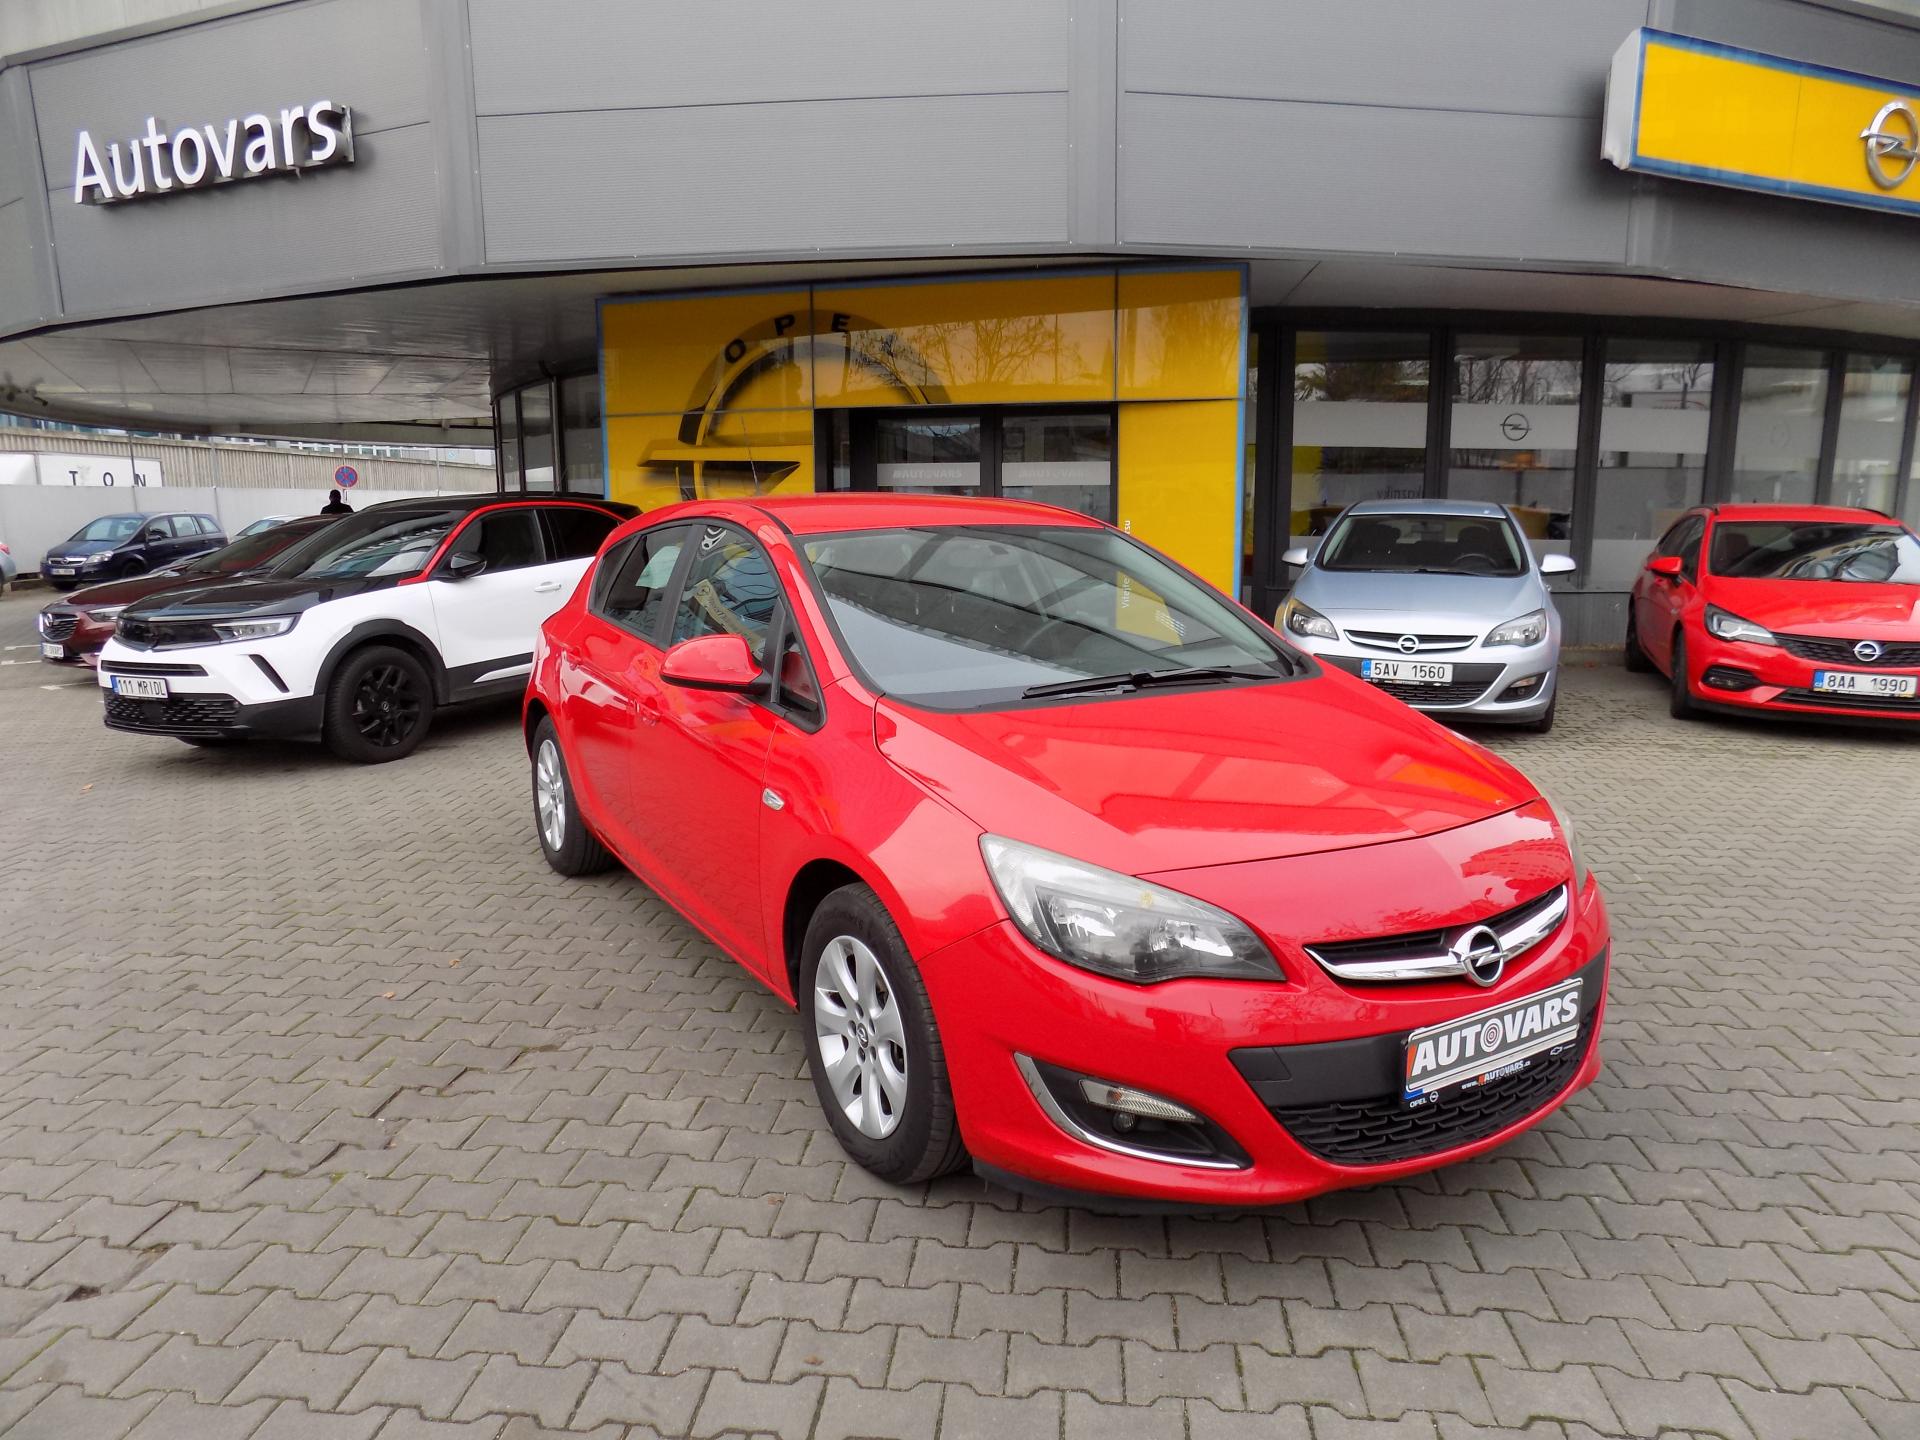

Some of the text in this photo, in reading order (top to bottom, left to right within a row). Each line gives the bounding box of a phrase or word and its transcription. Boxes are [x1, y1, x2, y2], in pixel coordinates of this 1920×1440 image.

[75, 100, 337, 203] Autovars
[1374, 662, 1445, 679] 5AV 1560
[118, 679, 133, 694] 111
[1827, 675, 1855, 689] 8AA
[1870, 678, 1908, 693] 1990
[1411, 991, 1578, 1076] AUTOVARS
[1410, 1097, 1427, 1108] OPEL
